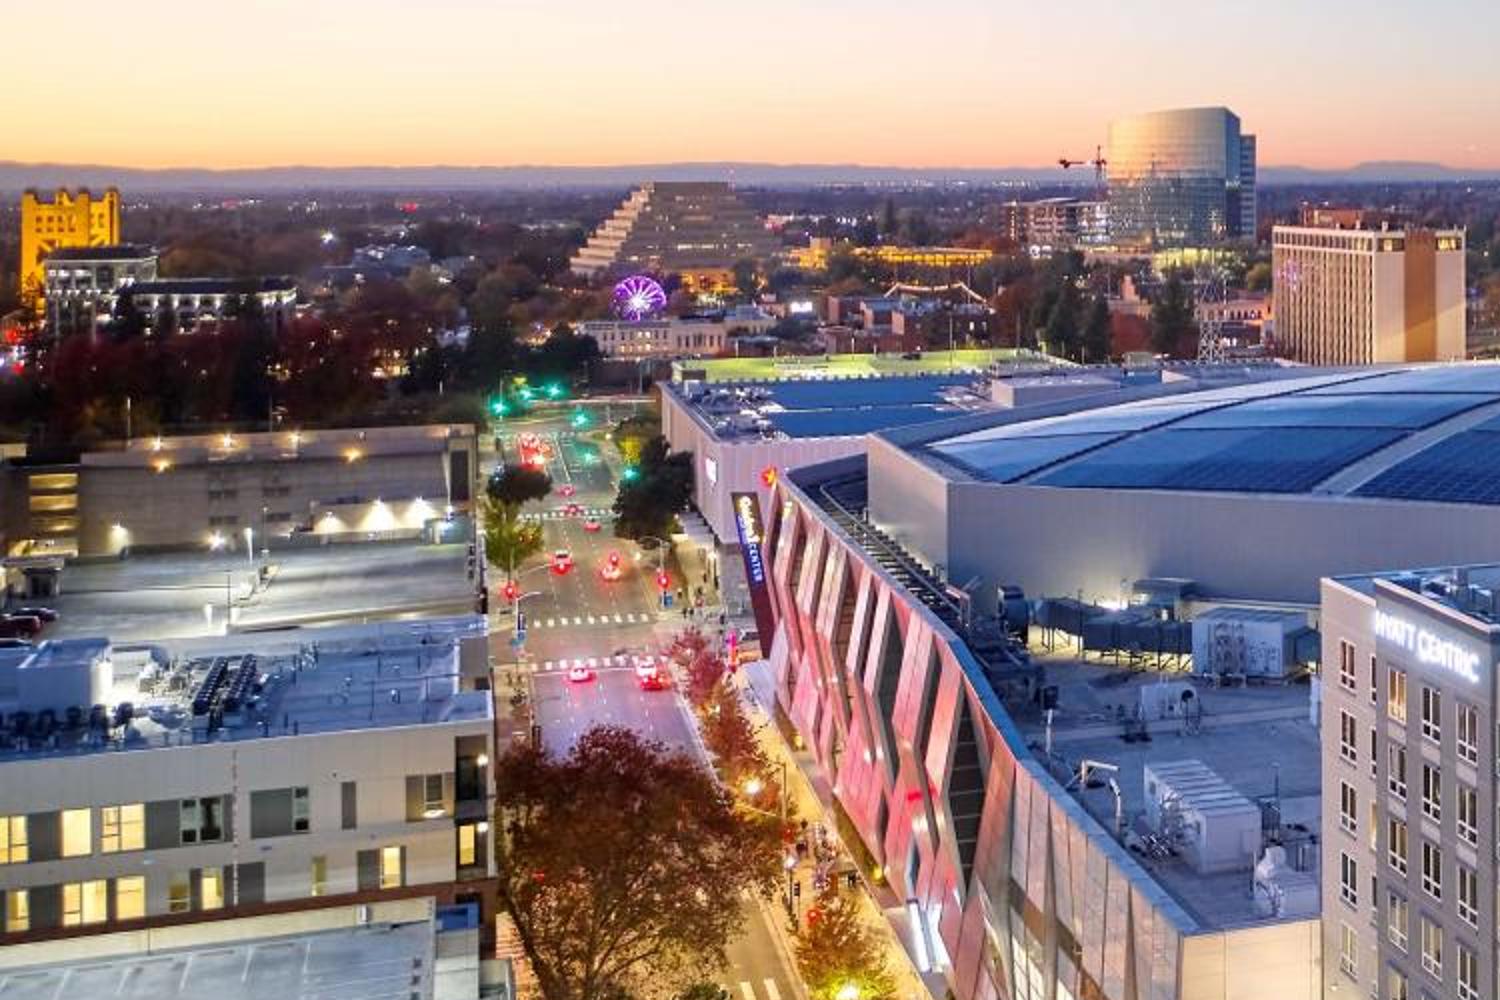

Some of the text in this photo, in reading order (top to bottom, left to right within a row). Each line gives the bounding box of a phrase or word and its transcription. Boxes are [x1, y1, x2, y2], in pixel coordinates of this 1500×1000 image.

[749, 543, 763, 581] CENTER
[1375, 610, 1480, 683] HYATT CENTRIC
